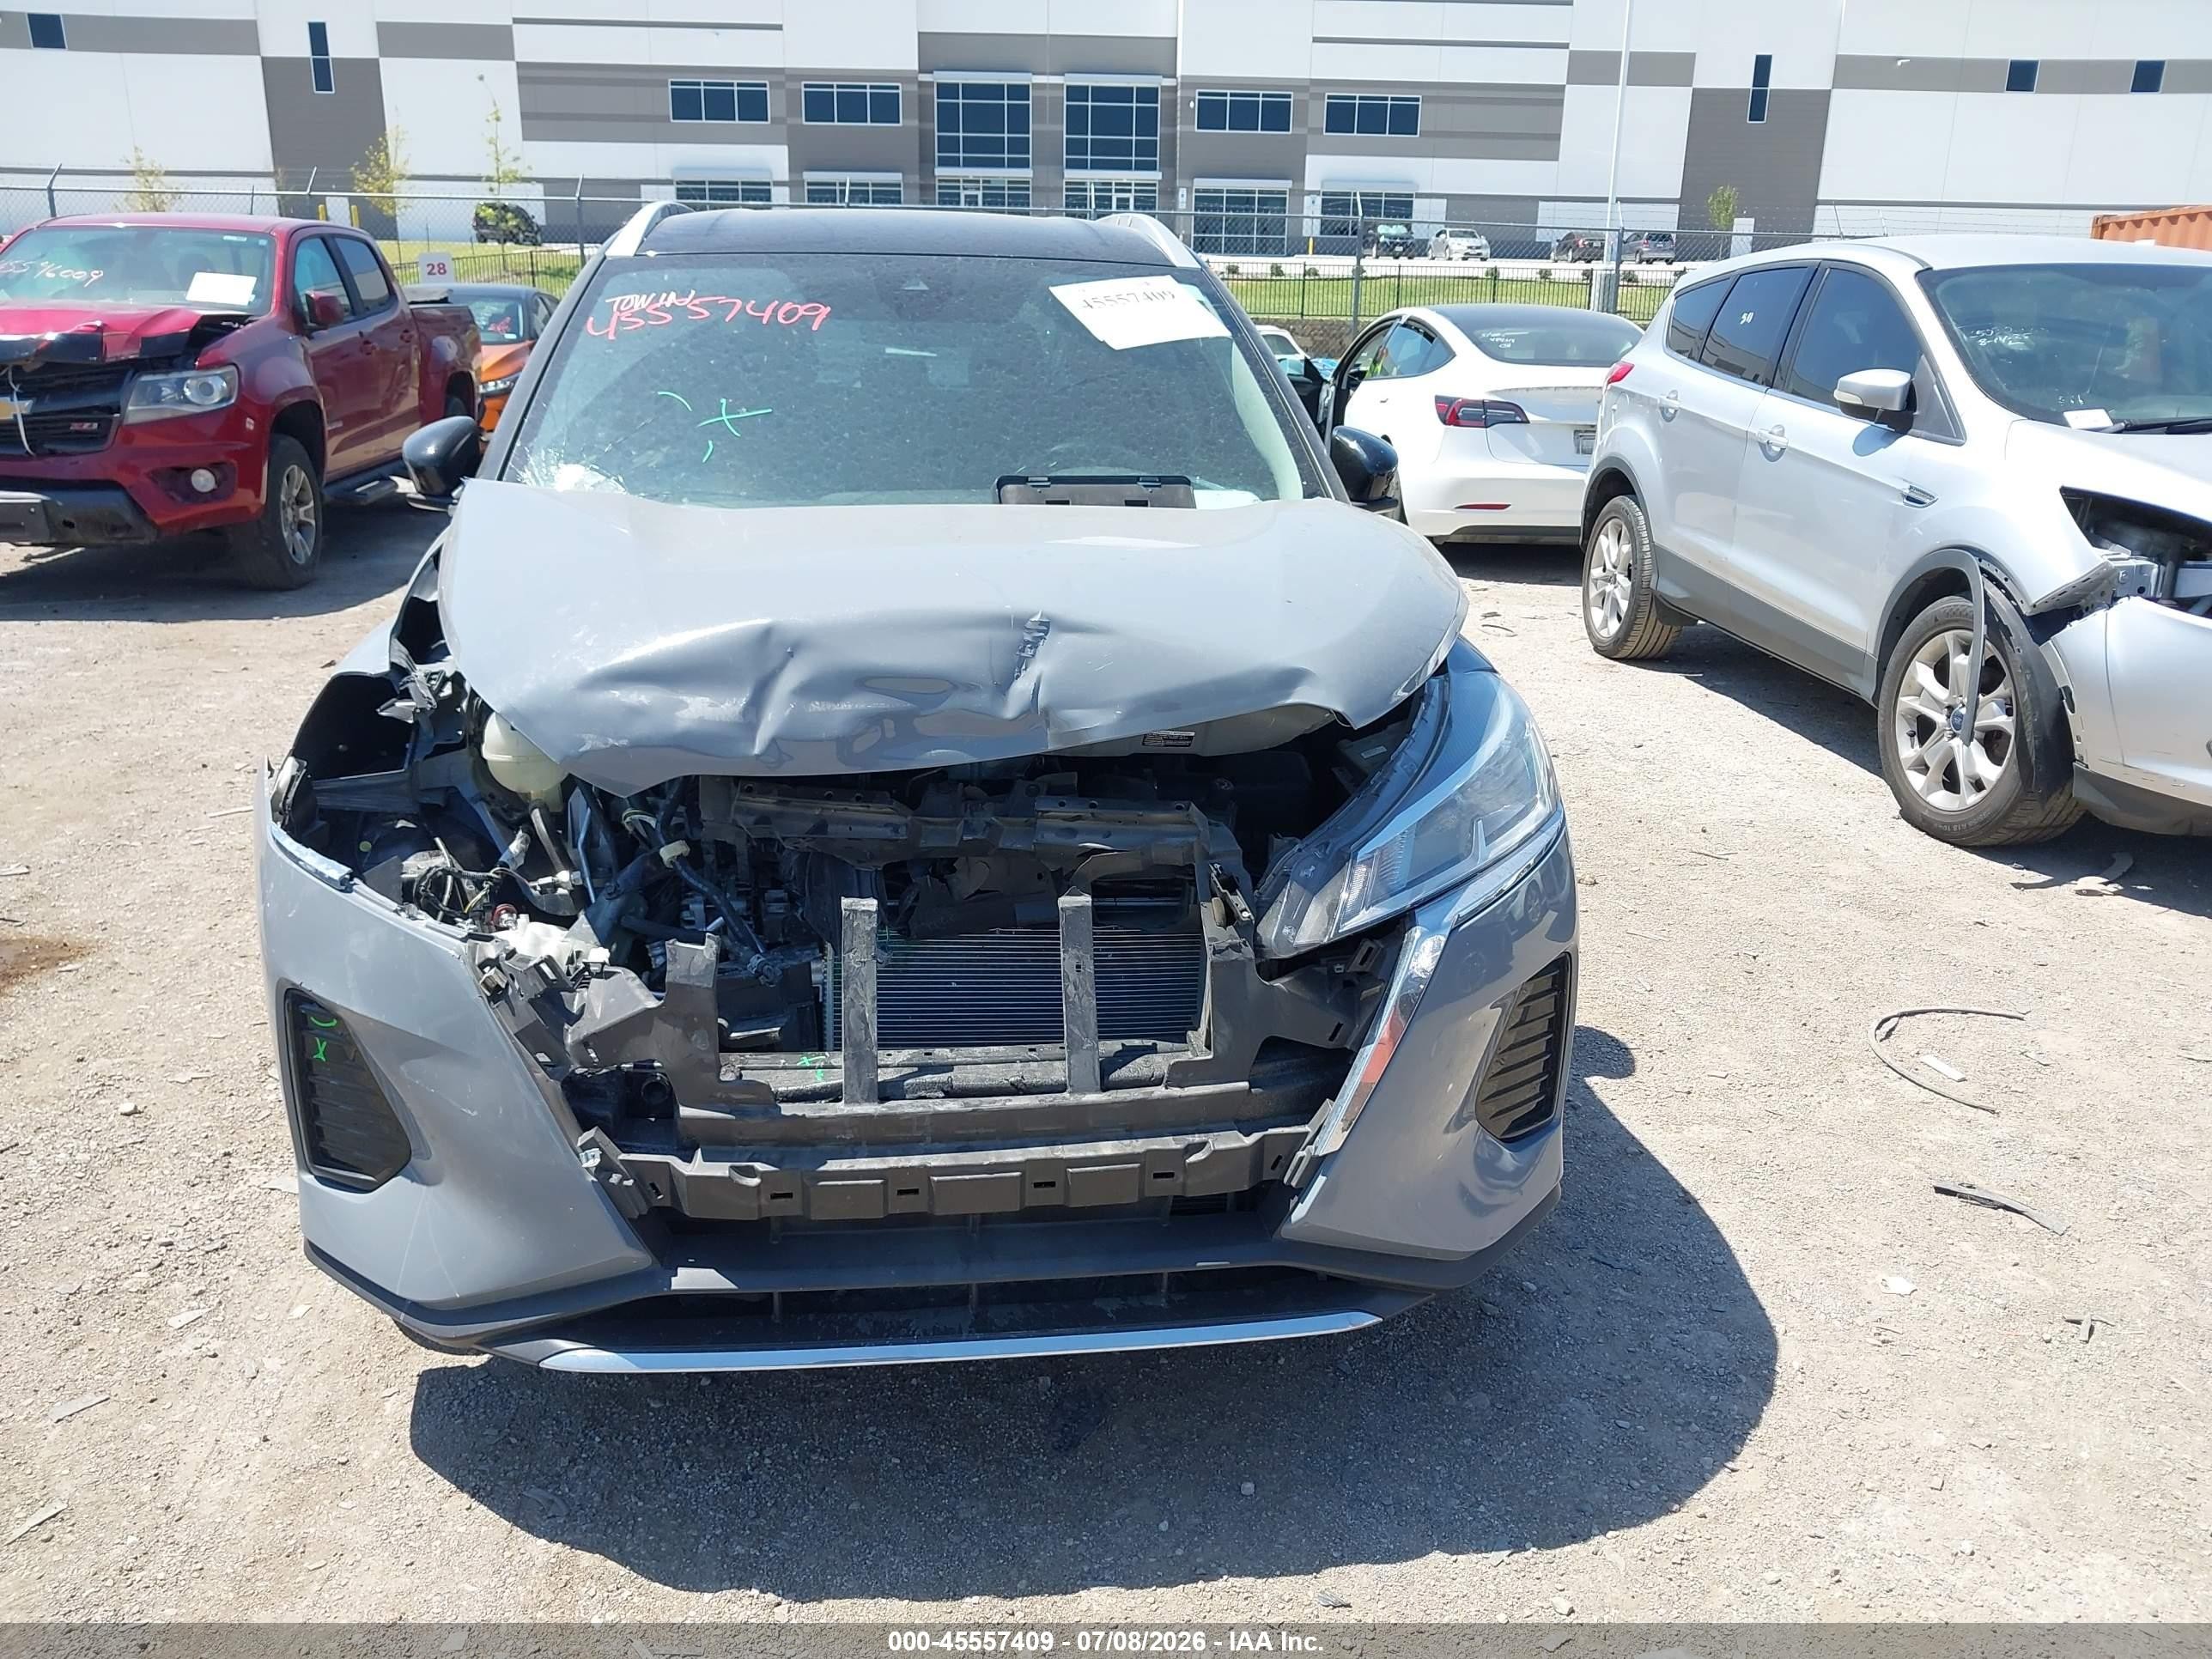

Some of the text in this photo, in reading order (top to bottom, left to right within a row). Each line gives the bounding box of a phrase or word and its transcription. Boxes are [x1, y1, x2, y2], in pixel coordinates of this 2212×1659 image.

[426, 262, 447, 276] 28
[605, 293, 656, 312] TOW
[1082, 289, 1176, 310] 45557409
